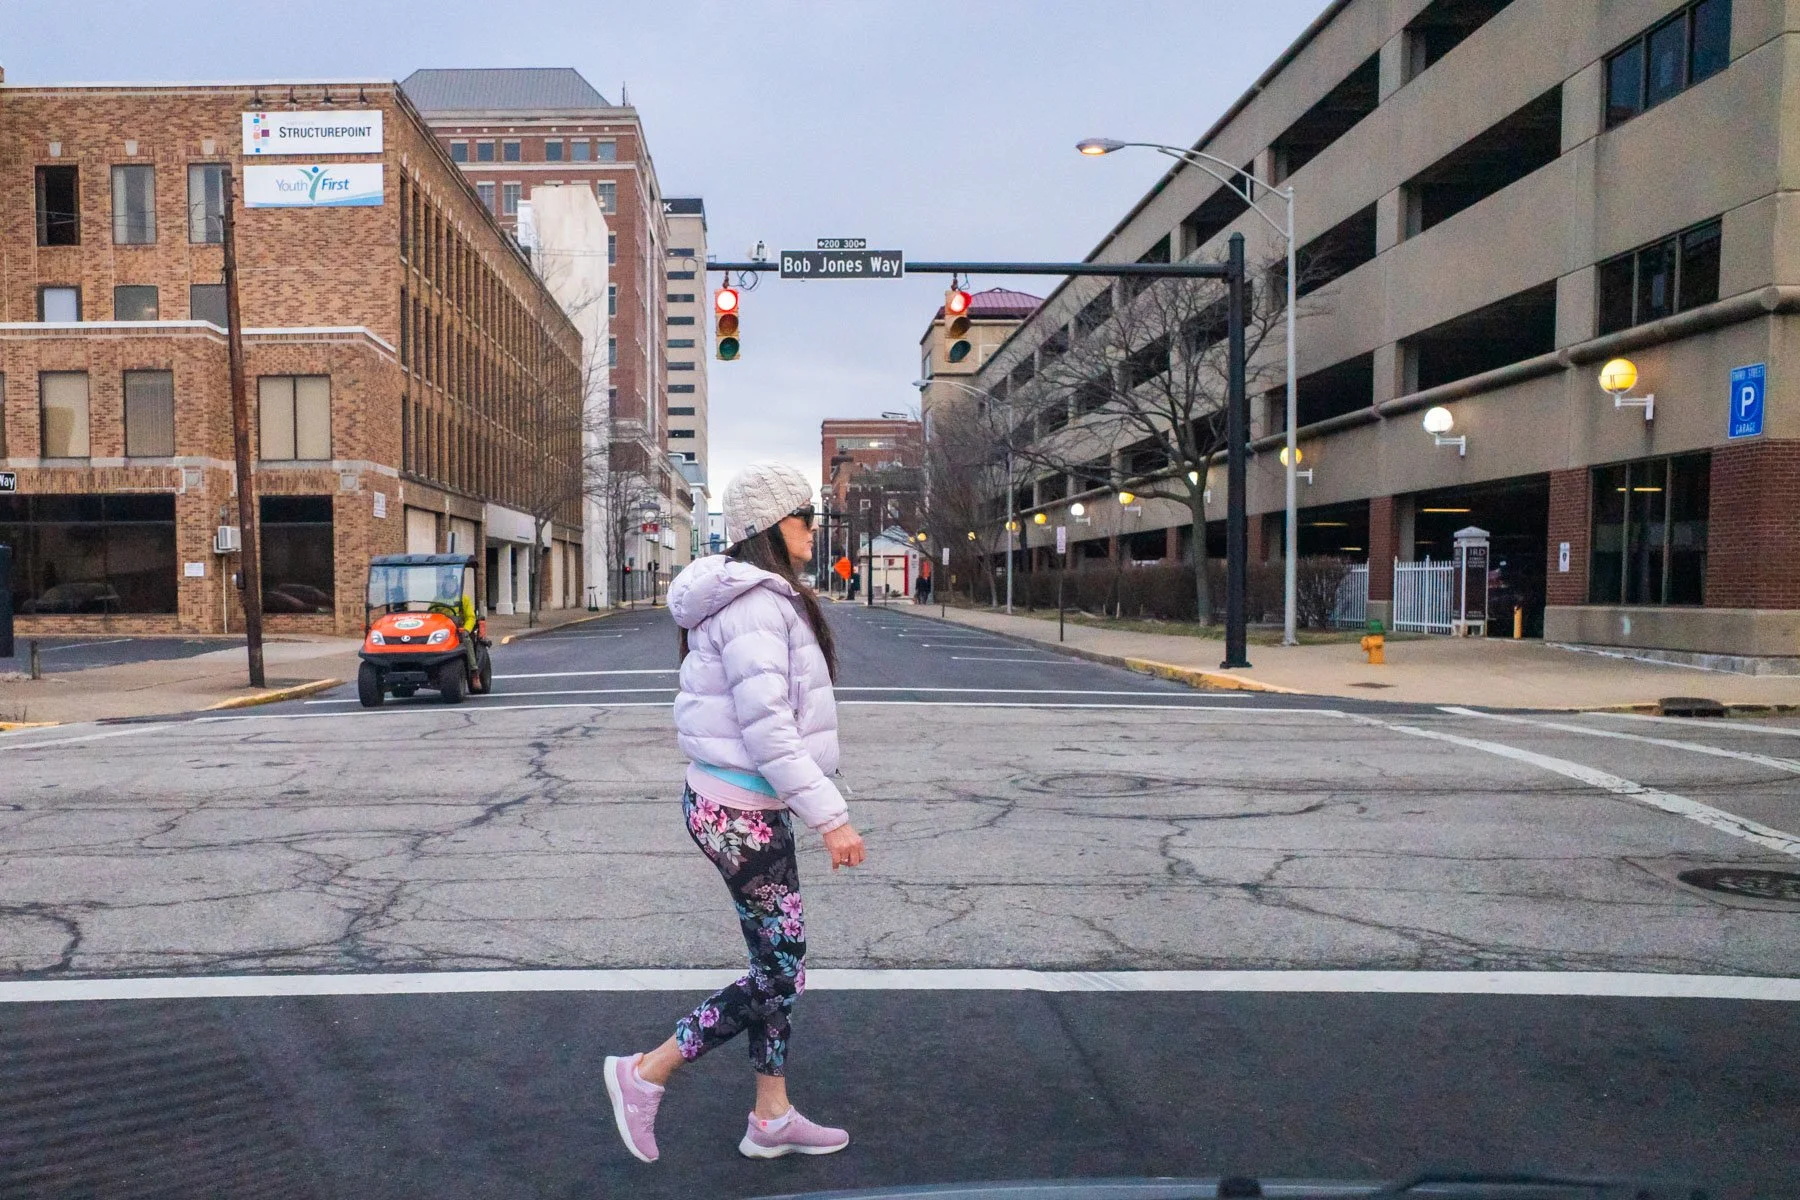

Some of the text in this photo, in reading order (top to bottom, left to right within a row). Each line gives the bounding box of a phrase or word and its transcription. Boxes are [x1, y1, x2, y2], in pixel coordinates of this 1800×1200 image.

[279, 126, 372, 139] STRUCTUREPOINT
[275, 177, 350, 192] Youth First
[824, 239, 859, 248] 200 300
[783, 256, 900, 276] Bob Jones Way
[1740, 386, 1755, 417] P
